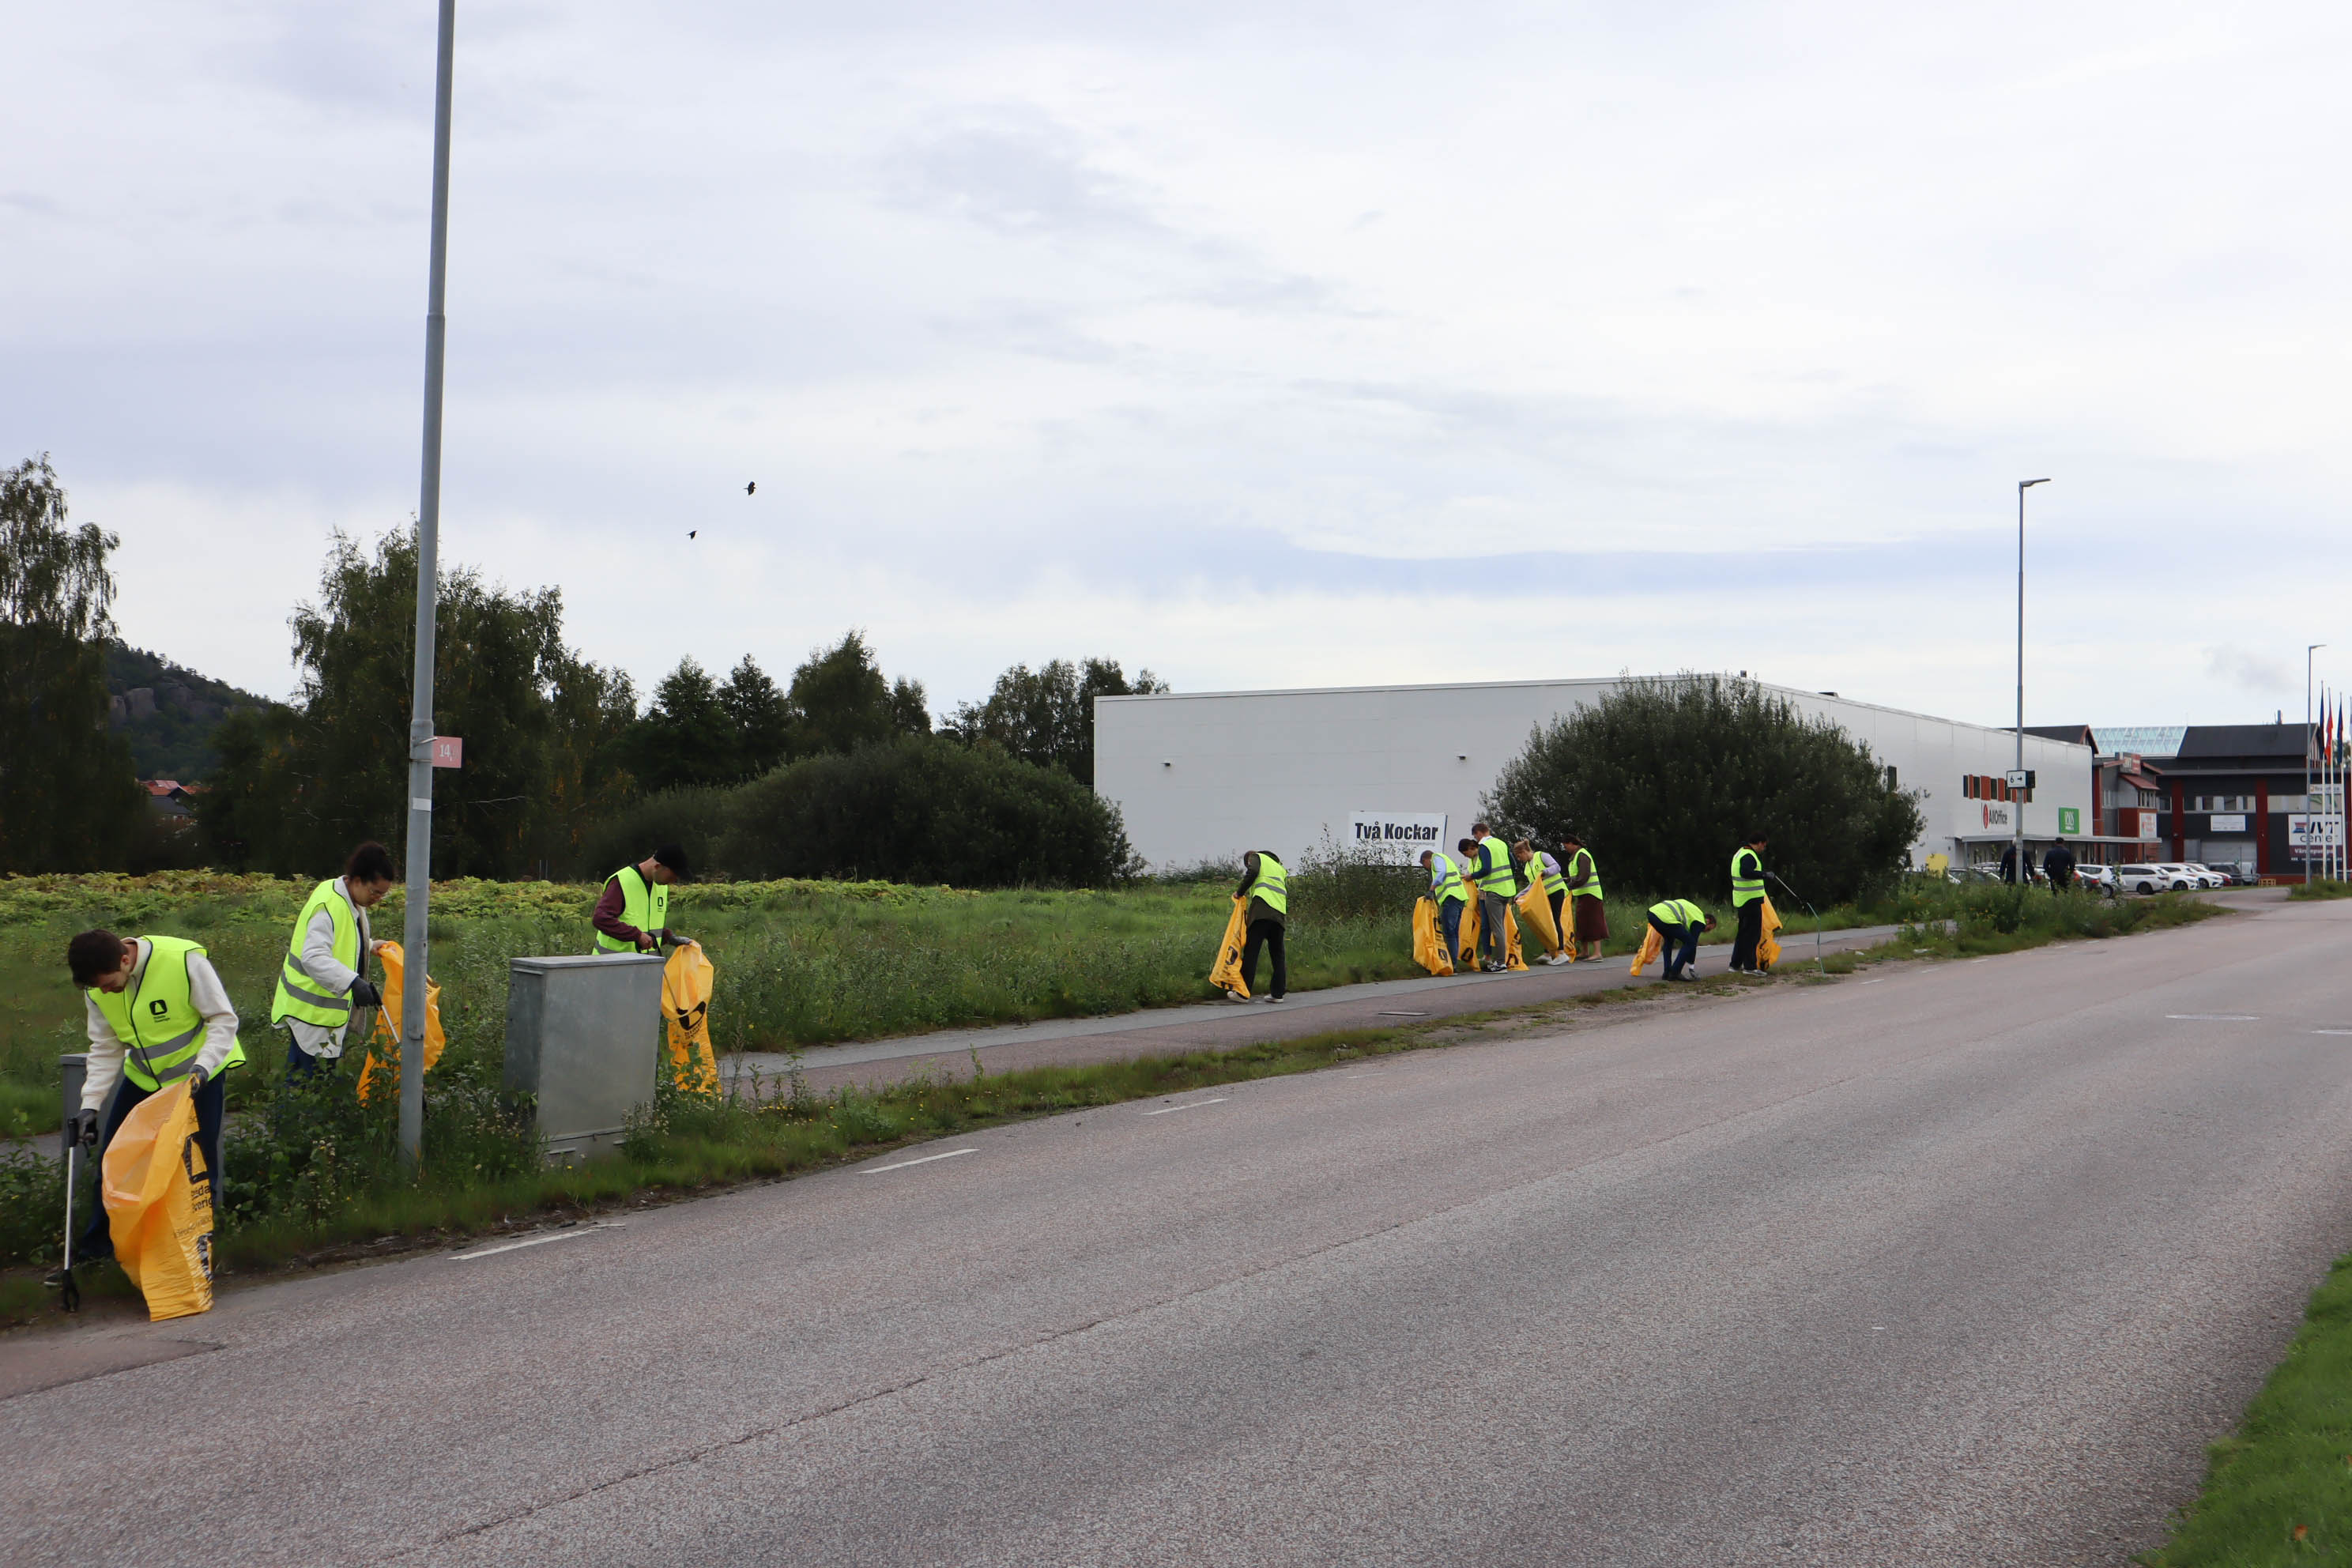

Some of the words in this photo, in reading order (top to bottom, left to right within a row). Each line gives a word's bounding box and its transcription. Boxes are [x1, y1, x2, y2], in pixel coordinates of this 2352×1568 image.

[1989, 808, 2008, 825] AllOffice
[1355, 820, 1381, 839] Två
[1384, 823, 1439, 841] Kockar
